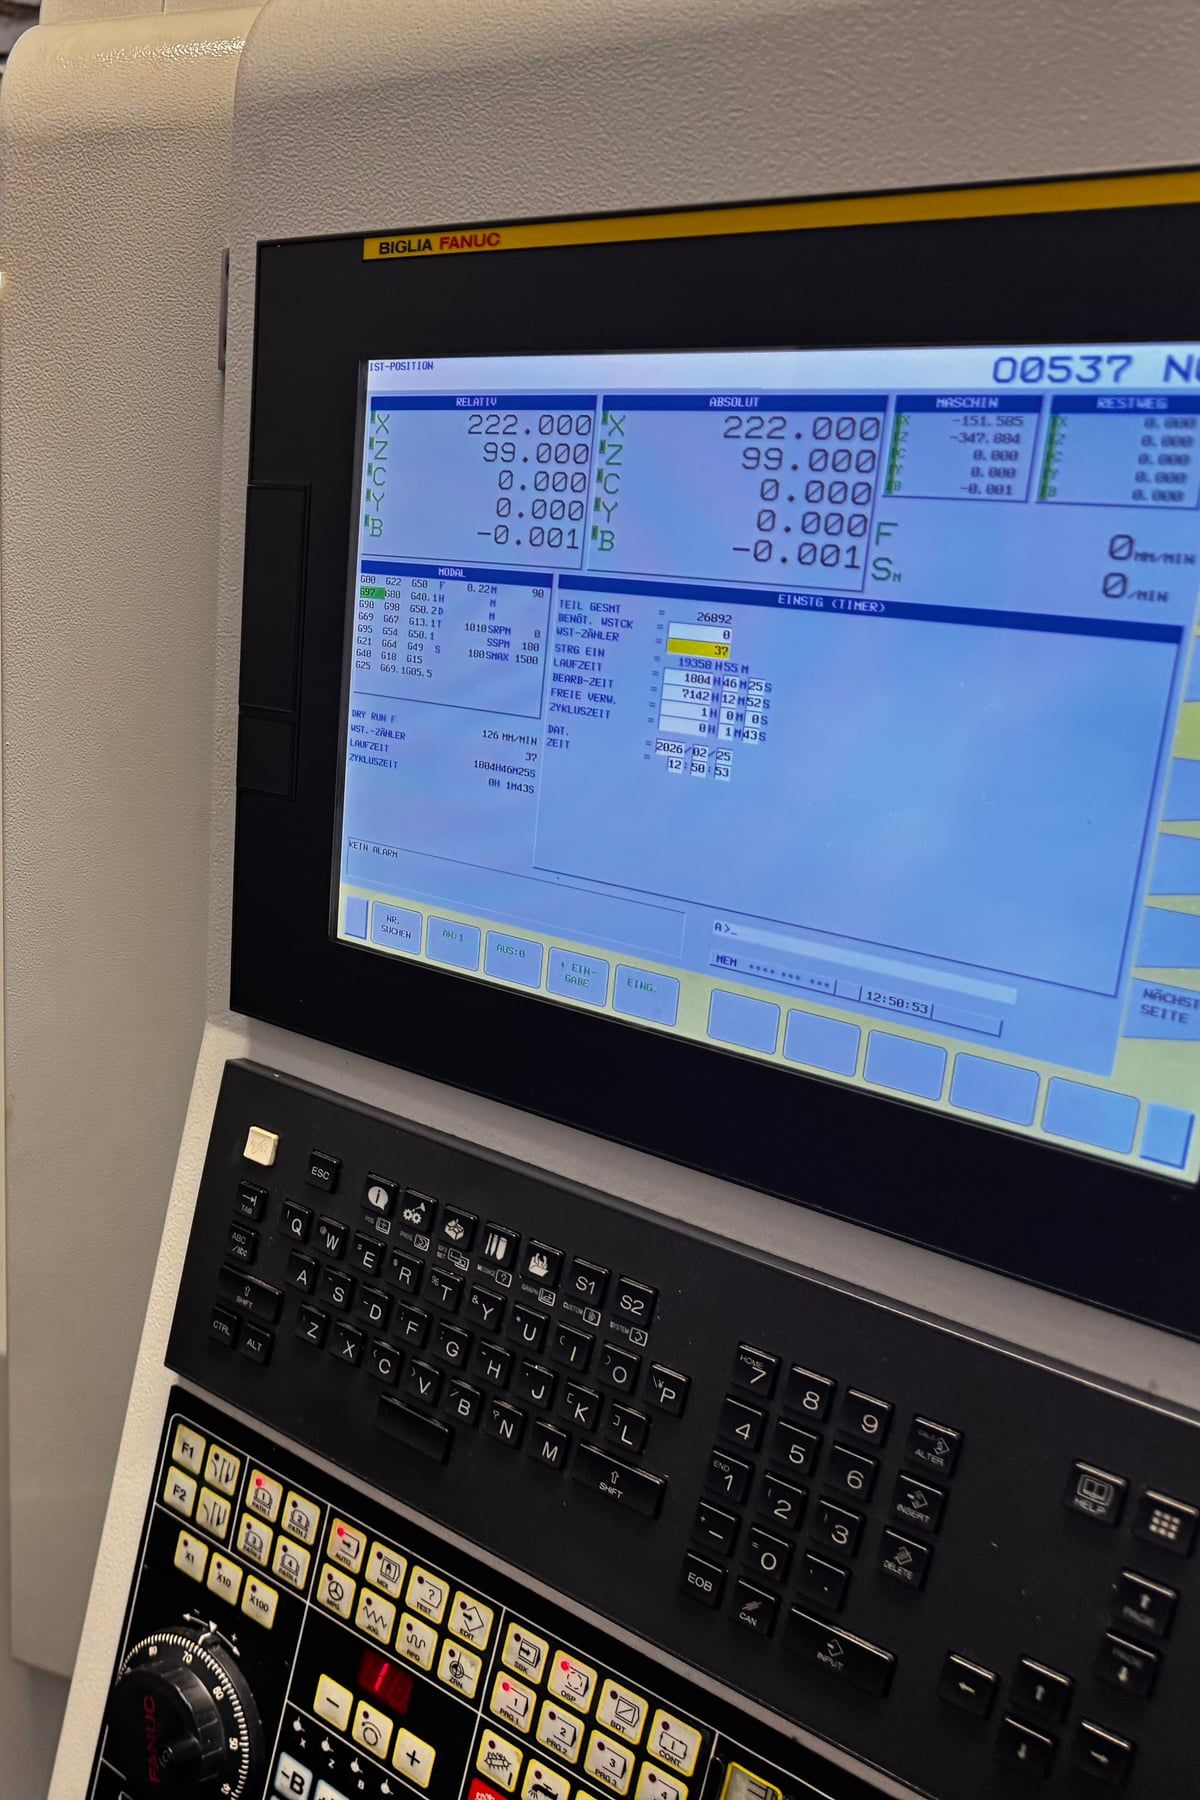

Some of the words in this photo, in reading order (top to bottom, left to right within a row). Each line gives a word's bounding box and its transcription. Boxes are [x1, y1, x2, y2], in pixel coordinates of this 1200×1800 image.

[379, 239, 432, 255] BIGLIA
[439, 232, 500, 250] FANUC
[370, 361, 434, 371] IST-POSITION
[1163, 354, 1200, 383] N
[456, 397, 497, 407] RELATIV
[709, 397, 760, 408] ABSOLUT
[936, 397, 999, 408] MASCHIN
[1096, 397, 1168, 409] RESTWEG
[376, 414, 390, 434] X
[468, 414, 592, 436] 222.000
[608, 414, 626, 437] X
[723, 415, 880, 440] 222.000
[374, 441, 388, 460] Z
[483, 442, 589, 464] 99.000
[605, 444, 623, 465] Z
[742, 447, 876, 473] 99.000
[372, 467, 386, 486] C
[499, 469, 586, 493] 0.000
[603, 473, 620, 494] C
[761, 478, 872, 505] 0.000
[372, 492, 385, 512] Y
[496, 497, 584, 521] 0.000
[602, 501, 618, 523] Y
[757, 509, 868, 537] 0.000
[369, 519, 383, 537] B
[477, 524, 579, 550] -0.001
[875, 522, 898, 546] F
[598, 530, 615, 551] B
[733, 539, 860, 569] -0.001
[438, 567, 466, 578] MODAL
[385, 577, 402, 586] G22
[360, 587, 376, 597] G97
[777, 593, 824, 607] EINSTG
[831, 598, 886, 612] (TIMER)
[559, 599, 583, 611] TEIL
[589, 602, 621, 614] GESMT
[697, 612, 732, 625] 26892
[357, 624, 373, 633] G95
[558, 613, 592, 625] BENÖT.
[601, 617, 634, 629] WSTCK
[356, 636, 372, 646] G21
[381, 639, 397, 648] G64
[407, 642, 424, 652] G49
[556, 627, 620, 642] WST-ZÄHLER
[714, 645, 729, 656] 37
[406, 654, 423, 664] G15
[554, 643, 580, 655] STRG
[585, 647, 605, 658] EIN
[679, 657, 712, 669] 19358
[355, 660, 371, 670] G25
[553, 658, 602, 672] LAUFZEIT
[552, 672, 614, 689] BEARB-ZEIT
[550, 687, 582, 700] FREIE
[587, 692, 616, 705] VERW.
[550, 702, 611, 720] ZYKLUSZEIT
[352, 709, 366, 719] DRY
[371, 712, 387, 722] RUN
[482, 729, 499, 741] 126
[501, 732, 538, 747] MM/MIN
[548, 724, 569, 736] DAT.
[350, 739, 389, 752] LAUFZEIT
[546, 737, 571, 750] ZEIT
[349, 752, 398, 769] ZYKLUSZEIT
[525, 752, 537, 762] 37
[348, 840, 369, 852] KEIN
[372, 845, 398, 858] ALARM
[386, 914, 399, 925] NR.
[381, 924, 412, 940] SUCHEN
[564, 974, 590, 988] GABE
[626, 977, 657, 993] EING.
[716, 954, 737, 967] MEM
[866, 991, 929, 1014] 12:50:53
[1141, 1003, 1190, 1024] SEITE
[311, 1166, 330, 1181] ESC
[291, 1218, 303, 1236] Q
[231, 1232, 246, 1245] ABC
[325, 1233, 339, 1250] W
[363, 1251, 375, 1268] E
[296, 1270, 307, 1285] A
[399, 1267, 412, 1285] R
[441, 1284, 453, 1301] T
[575, 1276, 596, 1295] S1
[332, 1287, 345, 1303] S
[369, 1303, 382, 1319] D
[481, 1303, 494, 1320] Y
[620, 1295, 644, 1316] S2
[213, 1320, 231, 1336] CTRL
[306, 1321, 319, 1339] Z
[406, 1319, 419, 1335] F
[523, 1323, 537, 1341] U
[246, 1338, 263, 1352] ALT
[342, 1340, 354, 1358] X
[445, 1341, 460, 1358] G
[378, 1357, 391, 1374] C
[740, 1354, 763, 1369] HOME
[487, 1362, 502, 1380] H
[612, 1366, 627, 1383] O
[750, 1367, 766, 1384] 7
[418, 1376, 431, 1394] V
[532, 1383, 545, 1400] J
[660, 1387, 676, 1403] P
[802, 1391, 820, 1410] 8
[457, 1398, 471, 1417] B
[574, 1402, 589, 1422] K
[499, 1420, 514, 1439] N
[735, 1424, 751, 1440] 4
[861, 1414, 878, 1434] 9
[620, 1425, 633, 1446] L
[182, 1442, 194, 1458] F1
[542, 1441, 558, 1462] M
[788, 1444, 806, 1464] 5
[915, 1449, 944, 1466] ALTER
[713, 1460, 730, 1473] END
[724, 1474, 733, 1492] 1
[847, 1470, 864, 1489] 6
[173, 1484, 187, 1501] F2
[599, 1481, 623, 1499] SHIFT
[773, 1500, 791, 1519] 2
[897, 1504, 930, 1523] INSERT
[1073, 1497, 1106, 1515] HELP
[831, 1525, 849, 1545] 3
[185, 1552, 194, 1564] X1
[336, 1552, 351, 1566] AUTO
[761, 1552, 777, 1571] 0
[883, 1560, 913, 1579] DELETE
[216, 1571, 232, 1588] X10
[687, 1572, 712, 1592] EOB
[249, 1591, 269, 1613] X100
[416, 1601, 432, 1615] TEST
[739, 1611, 758, 1627] CAN
[460, 1628, 474, 1641] EDIT
[560, 1690, 576, 1703] OSP
[610, 1720, 626, 1734] BDT
[659, 1750, 682, 1767] CONT
